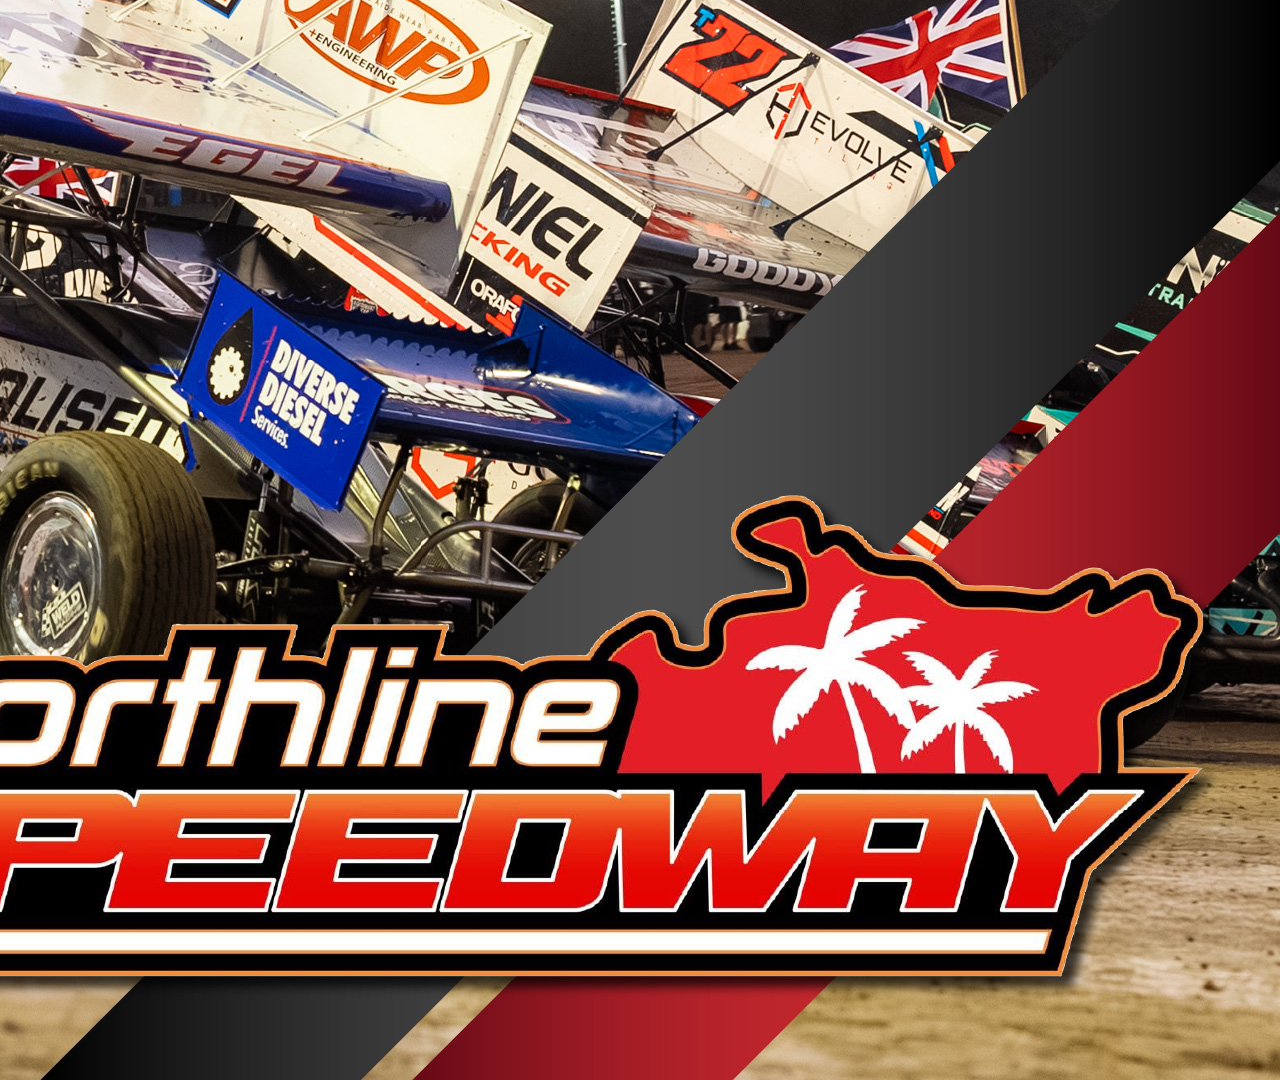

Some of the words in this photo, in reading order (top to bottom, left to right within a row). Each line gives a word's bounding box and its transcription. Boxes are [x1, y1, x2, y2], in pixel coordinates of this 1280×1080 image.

[663, 12, 789, 110] 22
[122, 125, 348, 194] EGEL
[809, 110, 913, 184] EVOLVE
[258, 371, 328, 447] DIESEL
[270, 338, 360, 426] DIVERSE
[372, 371, 558, 420] RGES
